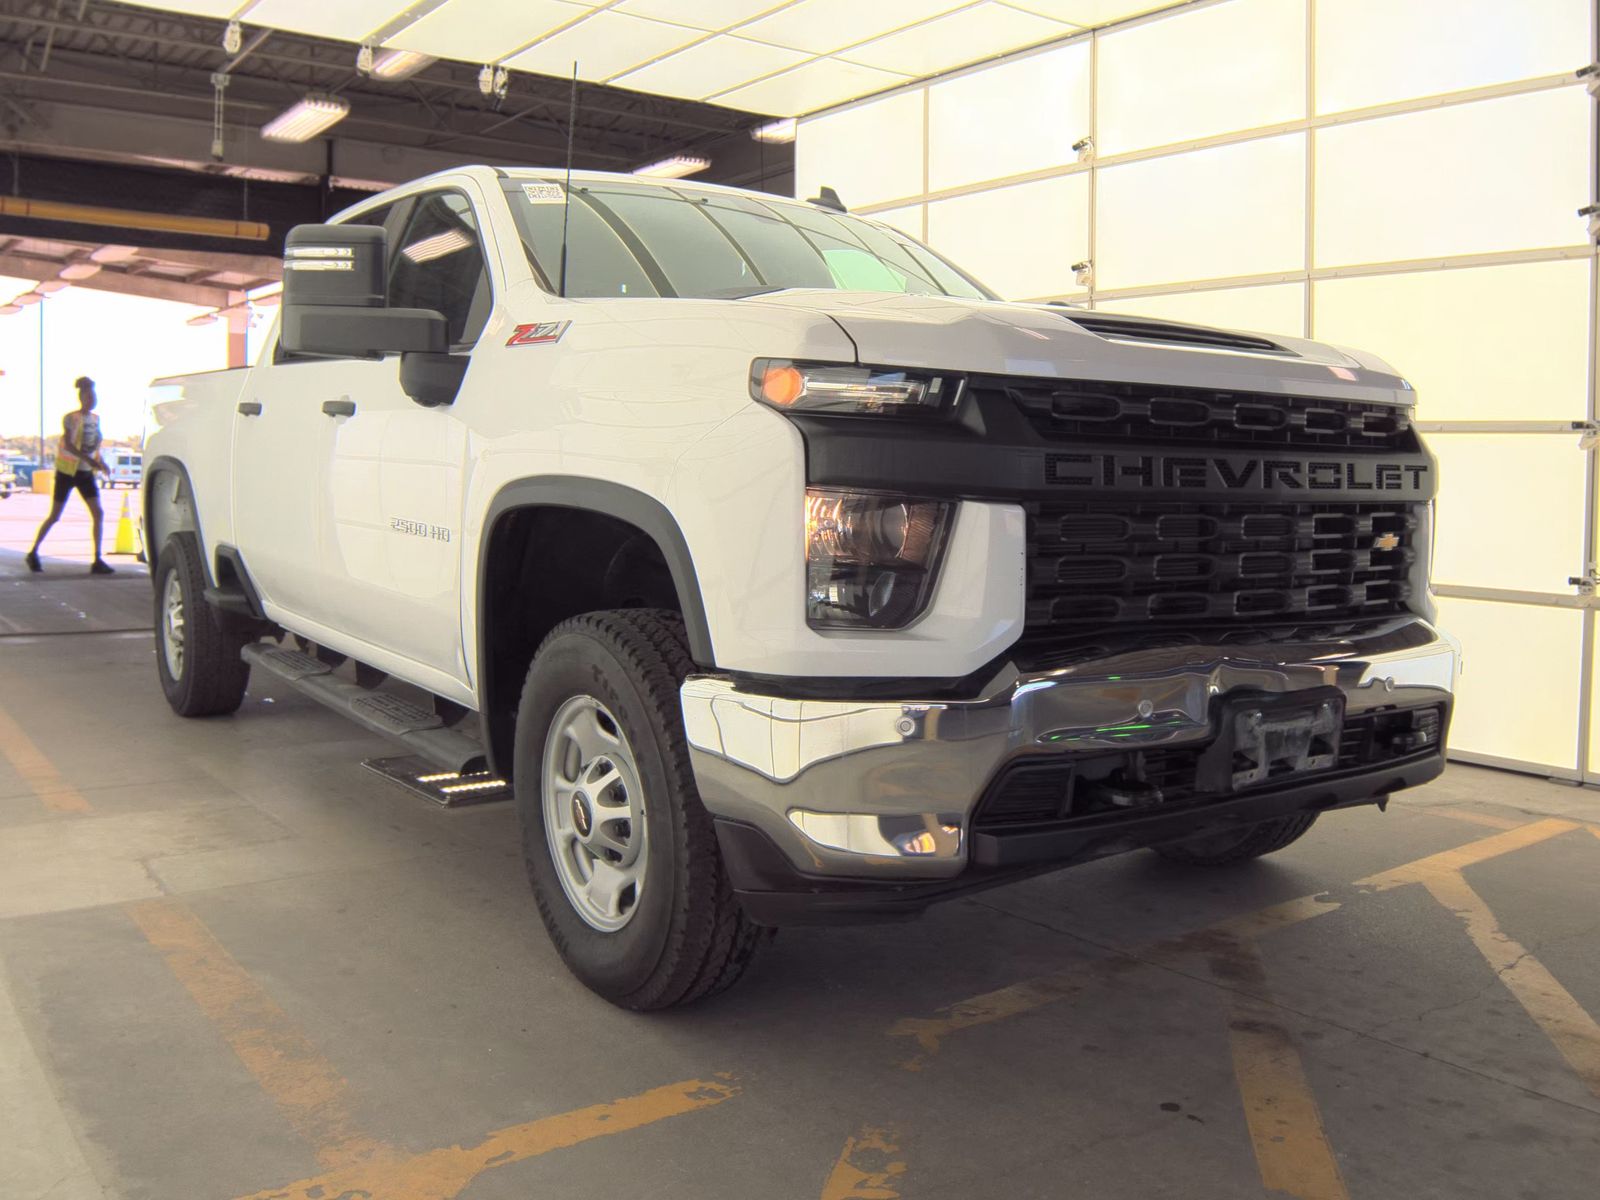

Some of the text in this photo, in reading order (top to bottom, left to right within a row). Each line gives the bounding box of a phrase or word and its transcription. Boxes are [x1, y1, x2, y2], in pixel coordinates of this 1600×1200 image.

[1044, 453, 1427, 489] CHEVROLET
[390, 517, 450, 542] 2500 HD
